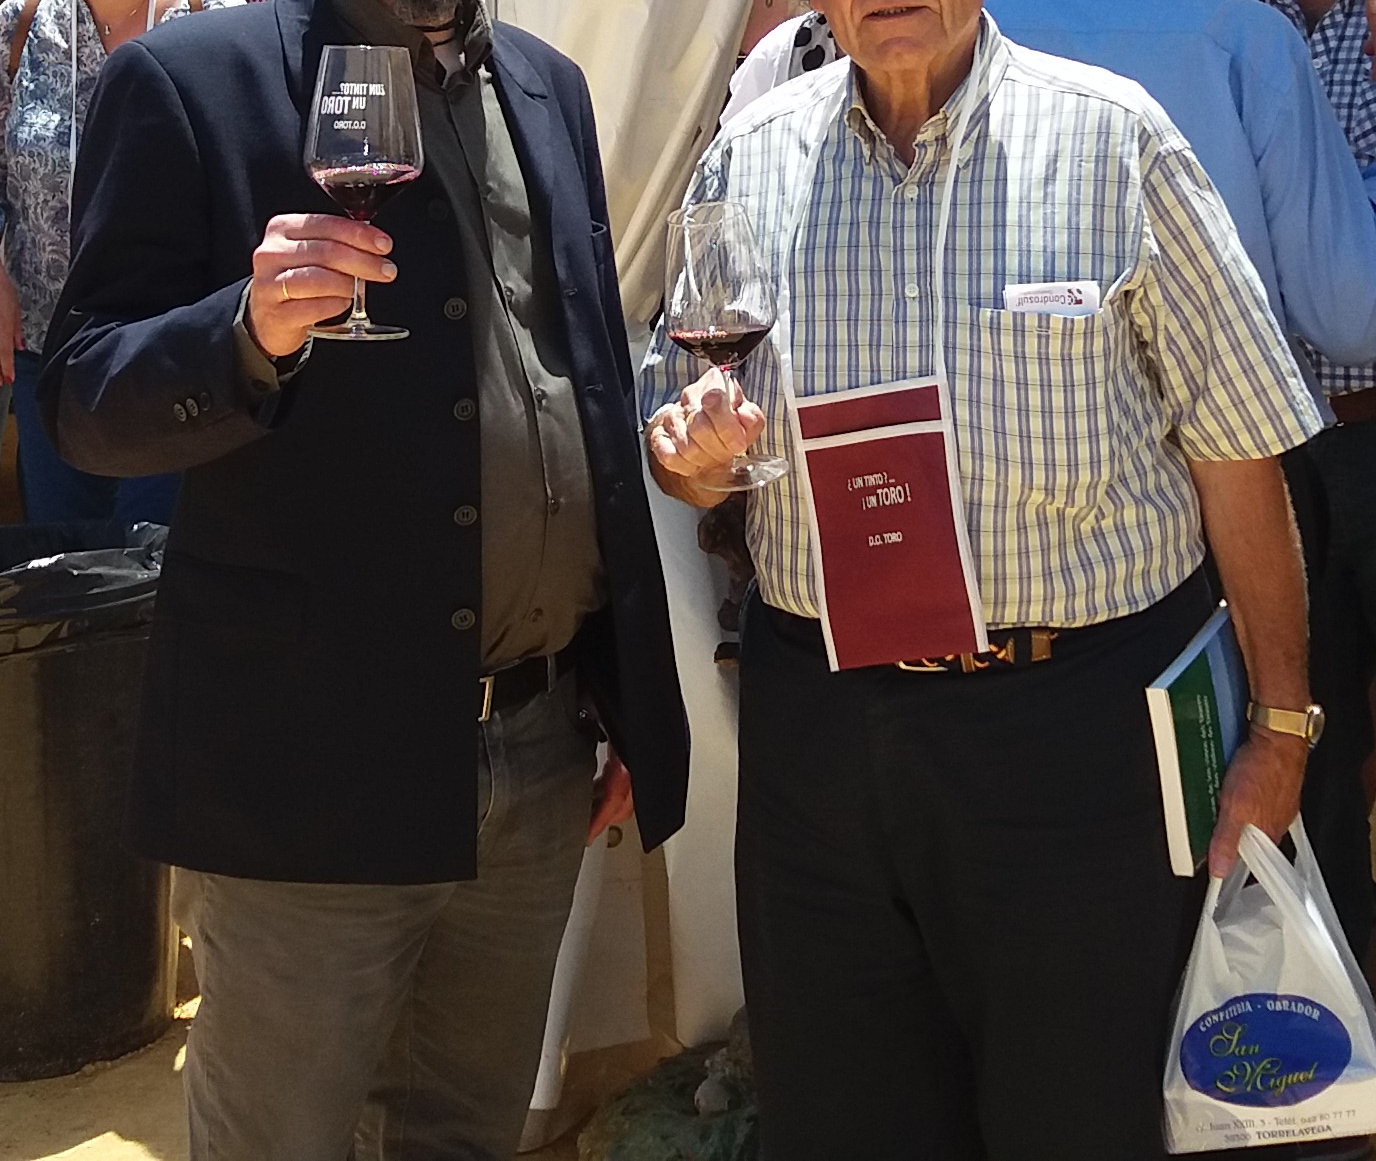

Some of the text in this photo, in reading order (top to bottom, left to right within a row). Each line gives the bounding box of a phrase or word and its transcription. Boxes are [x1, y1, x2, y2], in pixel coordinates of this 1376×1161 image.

[883, 531, 903, 544] TORO
[1266, 1000, 1321, 1021] OBRADOR
[1209, 1022, 1260, 1058] San
[1215, 1057, 1318, 1097] Miguel
[1256, 1124, 1333, 1140] TORRELAVEGA
